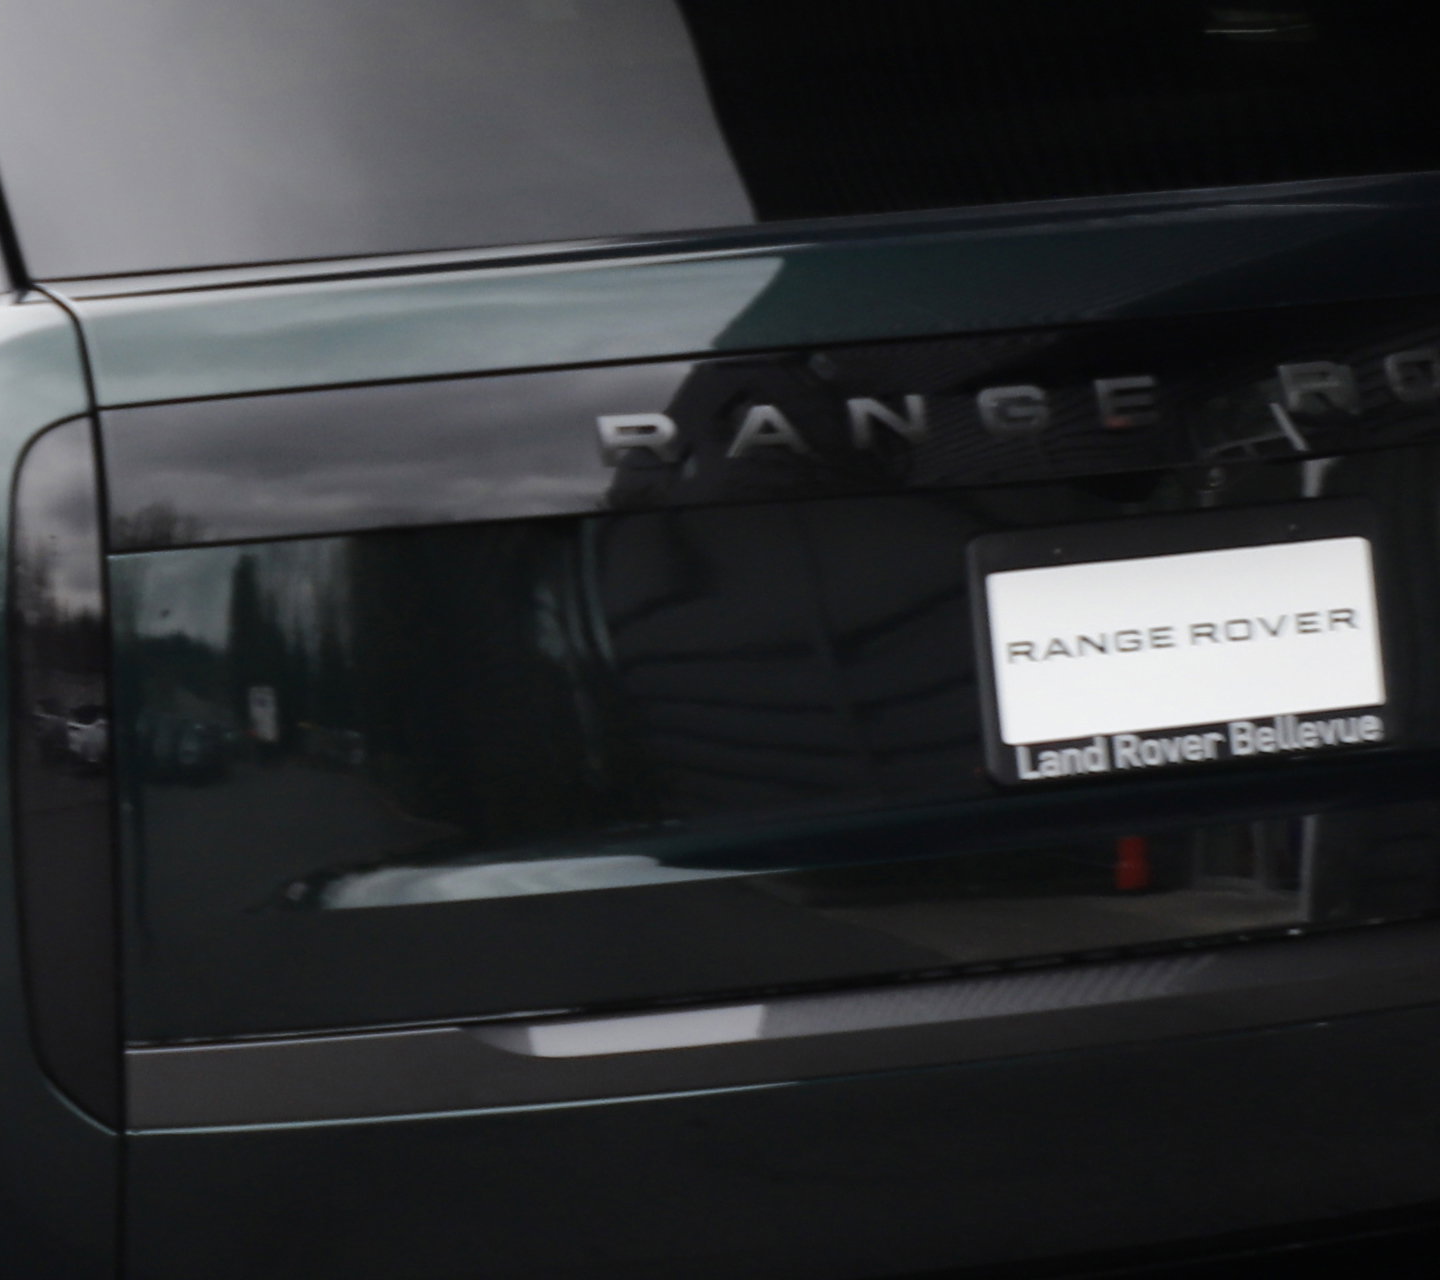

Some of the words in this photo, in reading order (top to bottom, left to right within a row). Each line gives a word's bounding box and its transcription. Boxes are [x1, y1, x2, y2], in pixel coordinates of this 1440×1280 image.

[595, 375, 1157, 468] RANGE
[1007, 625, 1175, 665] RANGE
[1189, 607, 1360, 647] ROVER
[1017, 735, 1110, 780] Land
[1113, 730, 1225, 770] Rover
[1228, 713, 1384, 757] Bellevue
